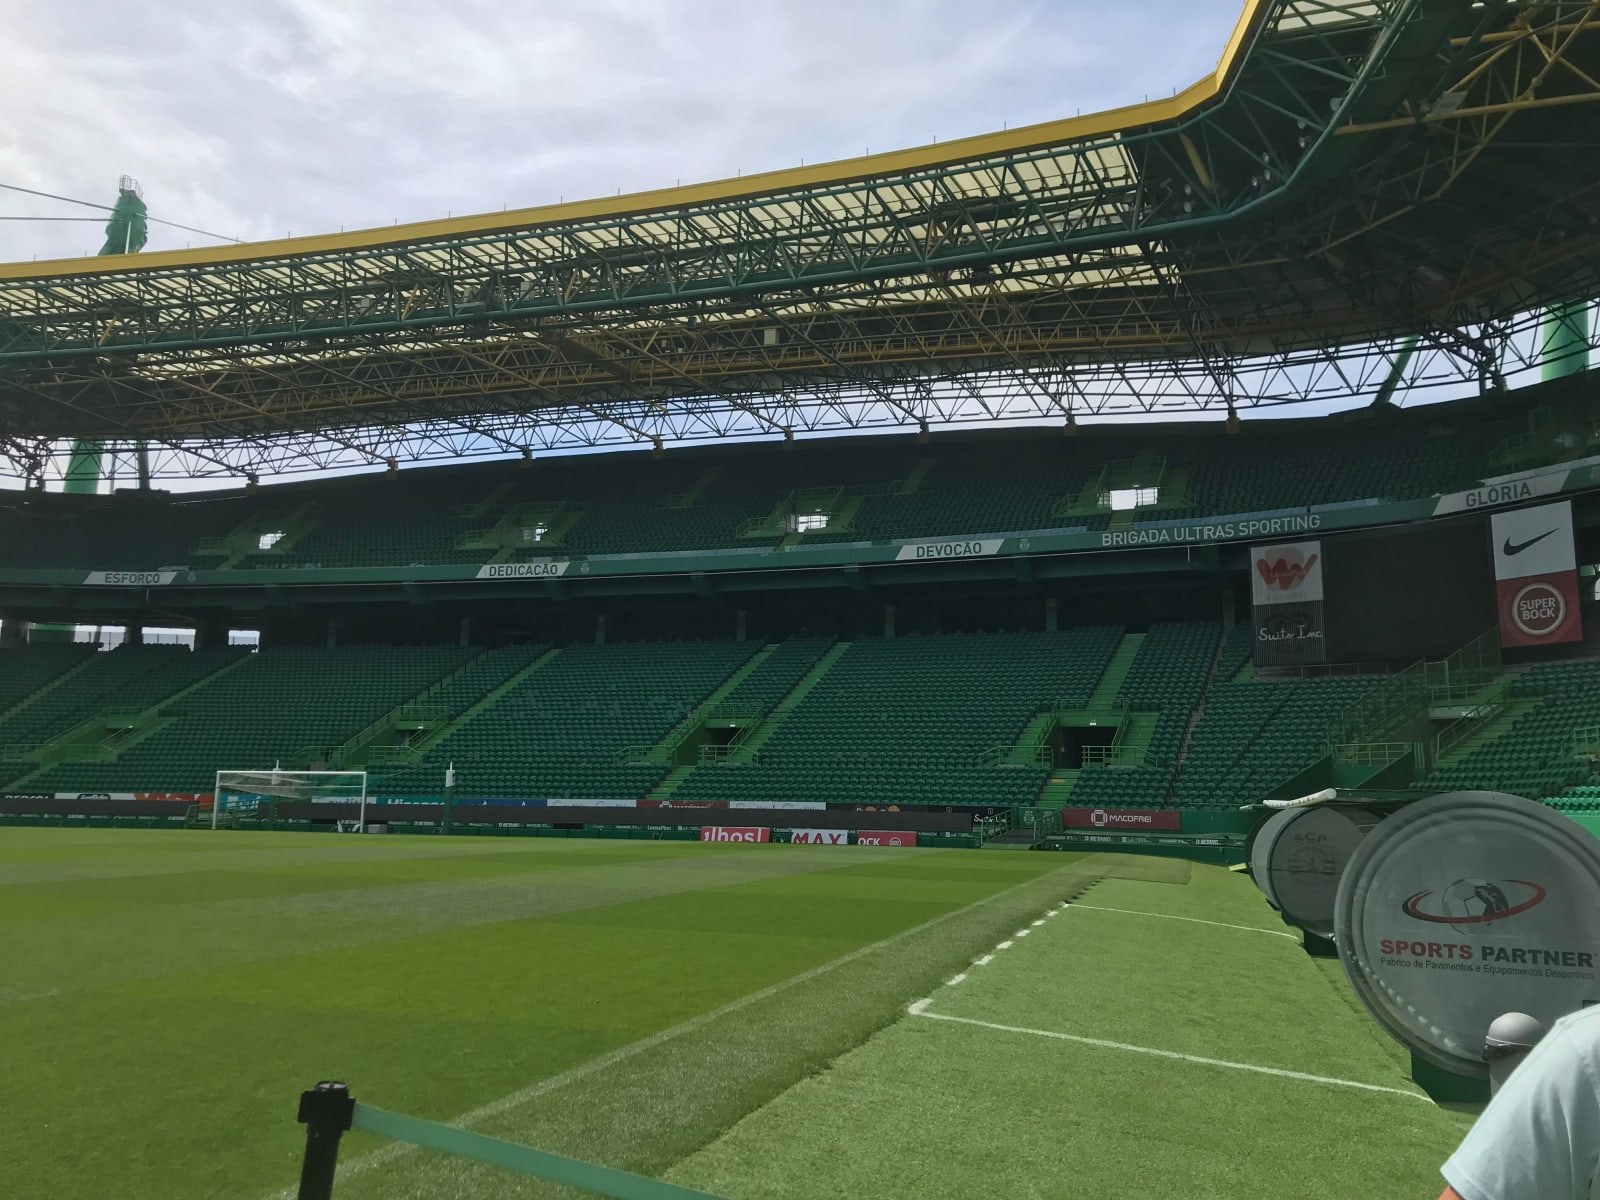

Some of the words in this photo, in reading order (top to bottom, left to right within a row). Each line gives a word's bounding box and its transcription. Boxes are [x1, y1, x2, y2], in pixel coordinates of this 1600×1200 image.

[1102, 529, 1170, 547] BRIGADA
[1173, 524, 1235, 542] ULTRAS
[1238, 514, 1321, 537] SPORTING
[1520, 597, 1556, 611] SUPER
[1522, 607, 1556, 620] BOCK
[1296, 624, 1323, 639] Inc
[1109, 814, 1152, 823] MACOFREI
[1380, 939, 1473, 960] SPORTS
[1481, 945, 1594, 968] PARTNER
[1380, 957, 1411, 968] Fabrico
[1413, 959, 1424, 969] de
[1425, 960, 1473, 972] Pavimentos
[1475, 964, 1481, 972] e
[1483, 964, 1543, 977] Equipamentos
